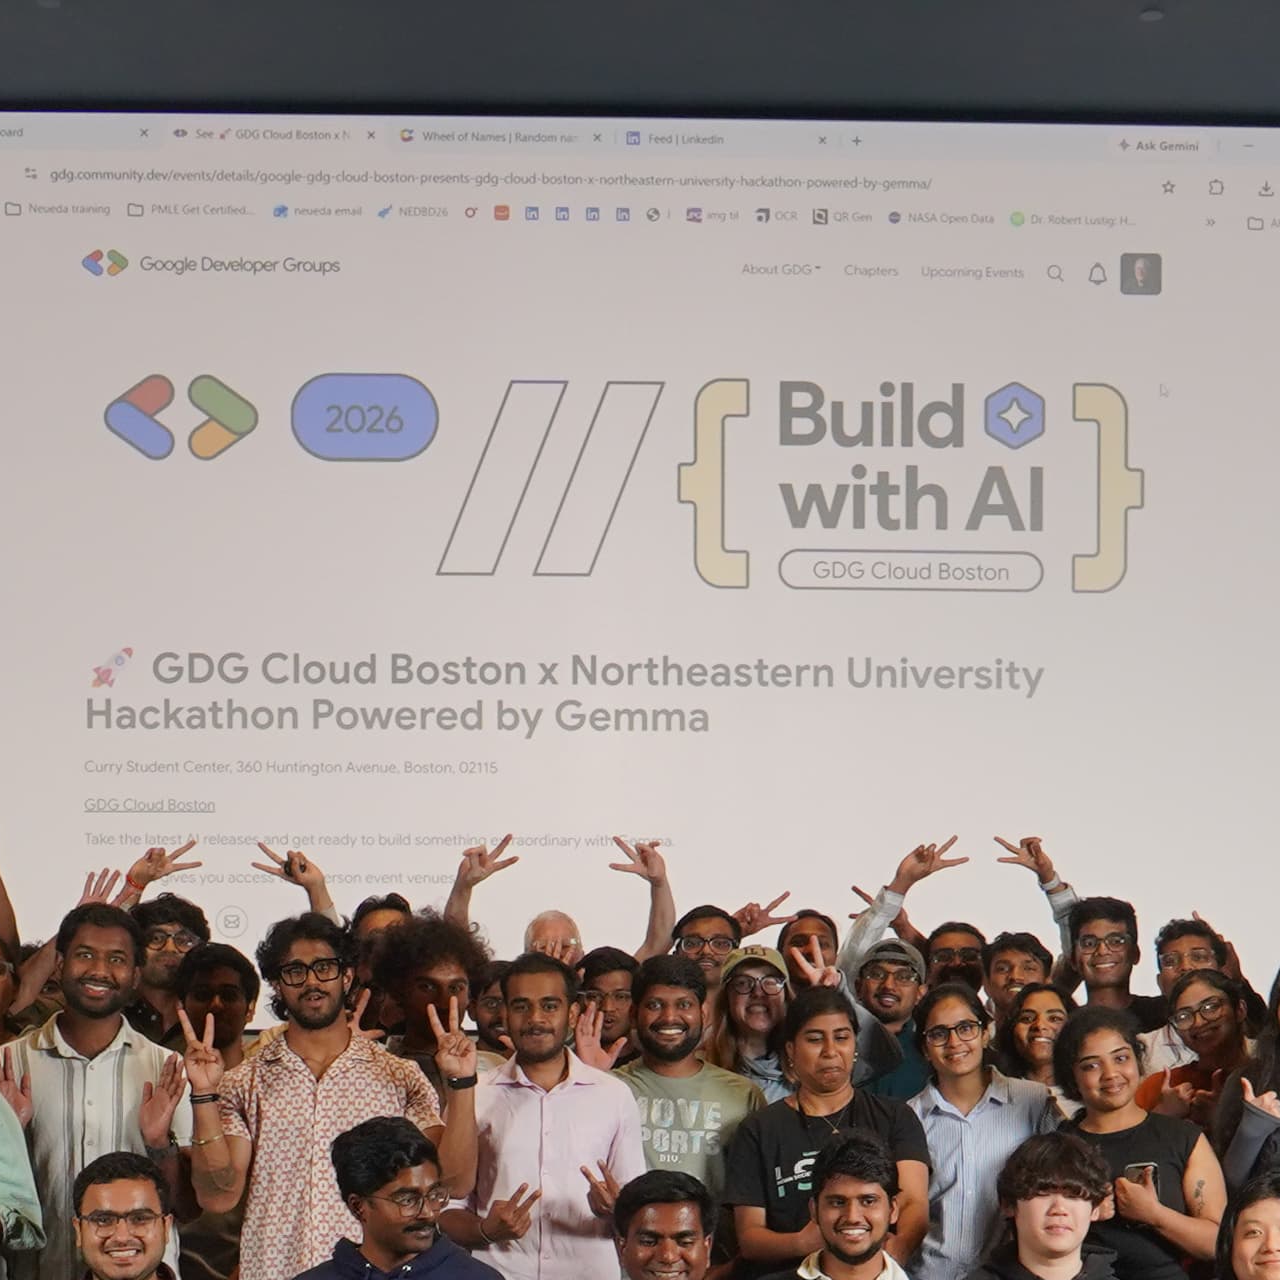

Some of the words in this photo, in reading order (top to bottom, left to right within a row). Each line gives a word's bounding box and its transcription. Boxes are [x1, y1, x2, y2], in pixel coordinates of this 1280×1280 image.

[196, 129, 214, 139] See
[235, 129, 260, 140] GDG
[263, 129, 293, 140] Cloud
[296, 130, 331, 140] Boston
[422, 132, 455, 141] Wheel
[457, 132, 472, 141] of
[471, 131, 506, 142] Names
[515, 132, 557, 143] Random
[649, 134, 672, 144] Feed
[682, 134, 724, 144] LinkedIn
[1136, 141, 1156, 151] Ask
[1160, 141, 1198, 151] Gemini
[72, 203, 110, 216] training
[182, 204, 200, 215] Get
[335, 206, 362, 216] email
[775, 208, 798, 222] OCR
[833, 212, 849, 222] QR
[851, 212, 872, 222] Gen
[908, 212, 937, 223] NASA
[940, 213, 969, 224] Open
[971, 213, 994, 224] Data
[1048, 214, 1081, 225] Robert
[140, 256, 197, 275] Google
[201, 256, 280, 275] Developer
[283, 257, 340, 276] Groups
[742, 264, 778, 275] About
[782, 264, 812, 275] GDG
[844, 264, 899, 278] Chapters
[921, 266, 983, 280] Upcoming
[986, 266, 1024, 280] Events
[325, 405, 404, 434] 2026
[779, 381, 965, 448] Build
[778, 463, 948, 531] with
[964, 466, 1044, 531] AI
[813, 561, 864, 579] GDG
[871, 561, 931, 580] Cloud
[939, 562, 1009, 581] Boston
[153, 652, 248, 684] GDG
[262, 652, 376, 685] Cloud
[391, 653, 526, 685] Boston
[538, 663, 558, 685] x
[572, 654, 833, 687] Northeastern
[848, 657, 1044, 698] University
[87, 698, 298, 730] Hackathon
[313, 699, 483, 731] Powered
[497, 700, 543, 739] by
[555, 700, 709, 732] Gemma
[84, 760, 123, 775] Curry
[127, 760, 179, 773] Student
[183, 760, 232, 774] Center,
[236, 760, 262, 773] 360
[266, 760, 342, 776] Huntington
[345, 761, 400, 776] Avenue,
[404, 761, 455, 774] Boston,
[459, 760, 498, 774] 02115
[84, 799, 120, 813] GDG
[123, 799, 164, 813] Cloud
[168, 799, 215, 813] Boston
[85, 833, 114, 846] Take
[119, 833, 141, 846] the
[145, 833, 182, 846] latest
[187, 834, 199, 845] AI
[203, 833, 258, 846] releases
[263, 833, 289, 846] and
[292, 835, 315, 849] get
[319, 834, 357, 849] ready
[361, 834, 375, 846] to
[379, 833, 411, 846] build
[415, 834, 486, 850] something
[490, 834, 581, 850] eraordinary
[585, 834, 613, 847] with
[162, 872, 196, 887] gives
[199, 875, 224, 888] you
[227, 873, 273, 885] access
[365, 872, 405, 886] event
[408, 874, 454, 886] venues
[639, 1127, 721, 1156] PORTS
